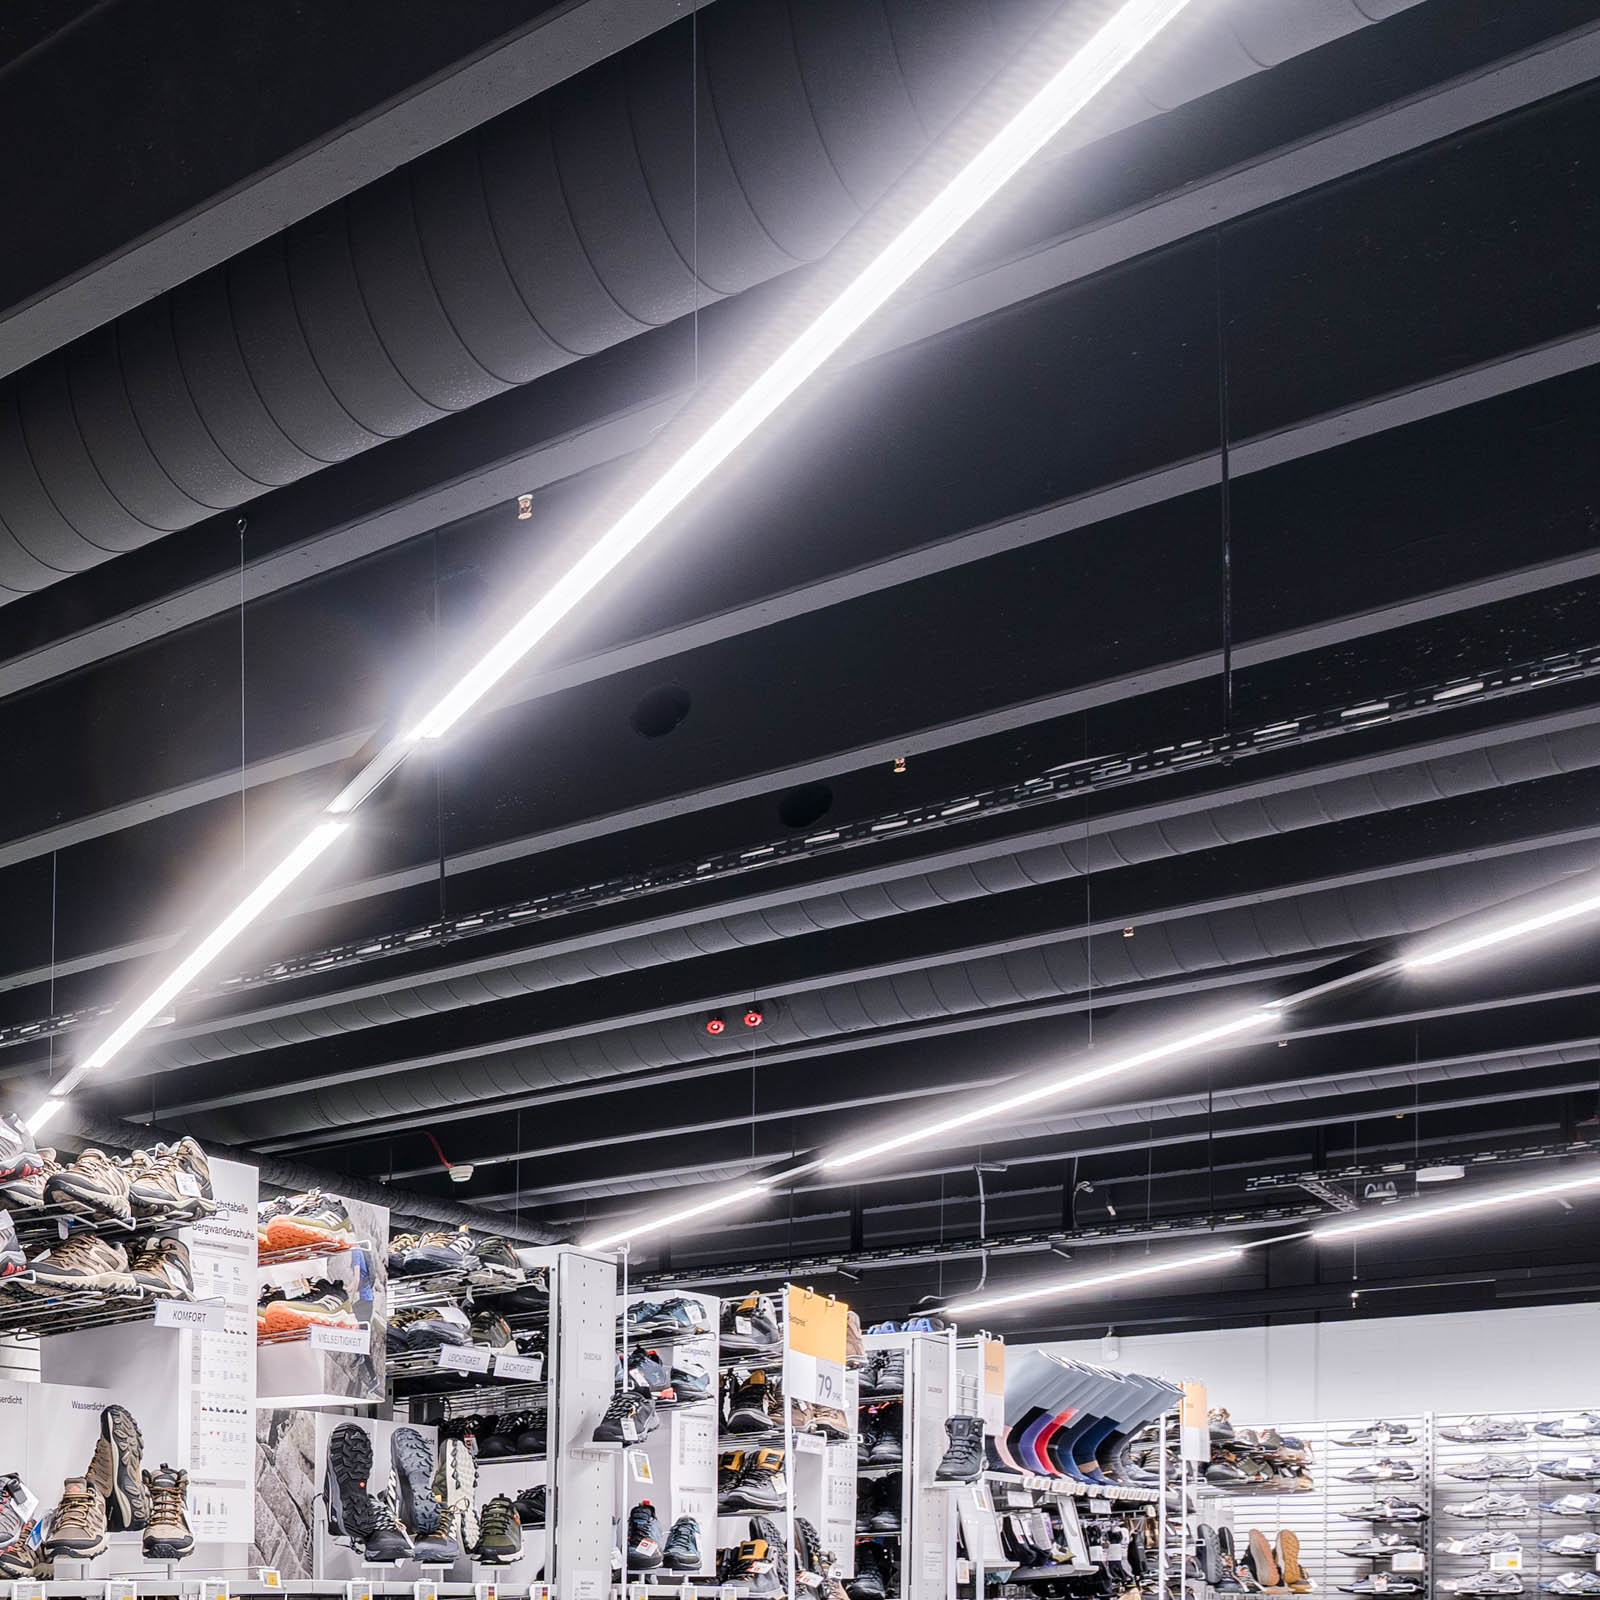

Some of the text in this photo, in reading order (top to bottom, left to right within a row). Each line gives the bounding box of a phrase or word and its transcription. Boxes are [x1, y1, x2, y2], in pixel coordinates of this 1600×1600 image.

[192, 1221, 255, 1241] Bergwanderschuhe
[172, 1309, 207, 1324] KOMFORT
[317, 1333, 363, 1348] VIELSEITIGKEIT
[447, 1351, 481, 1366] LEICHTIGKEIT
[502, 1361, 534, 1375] LEICHTIGKEIT
[71, 1400, 106, 1411] Wasserdicht
